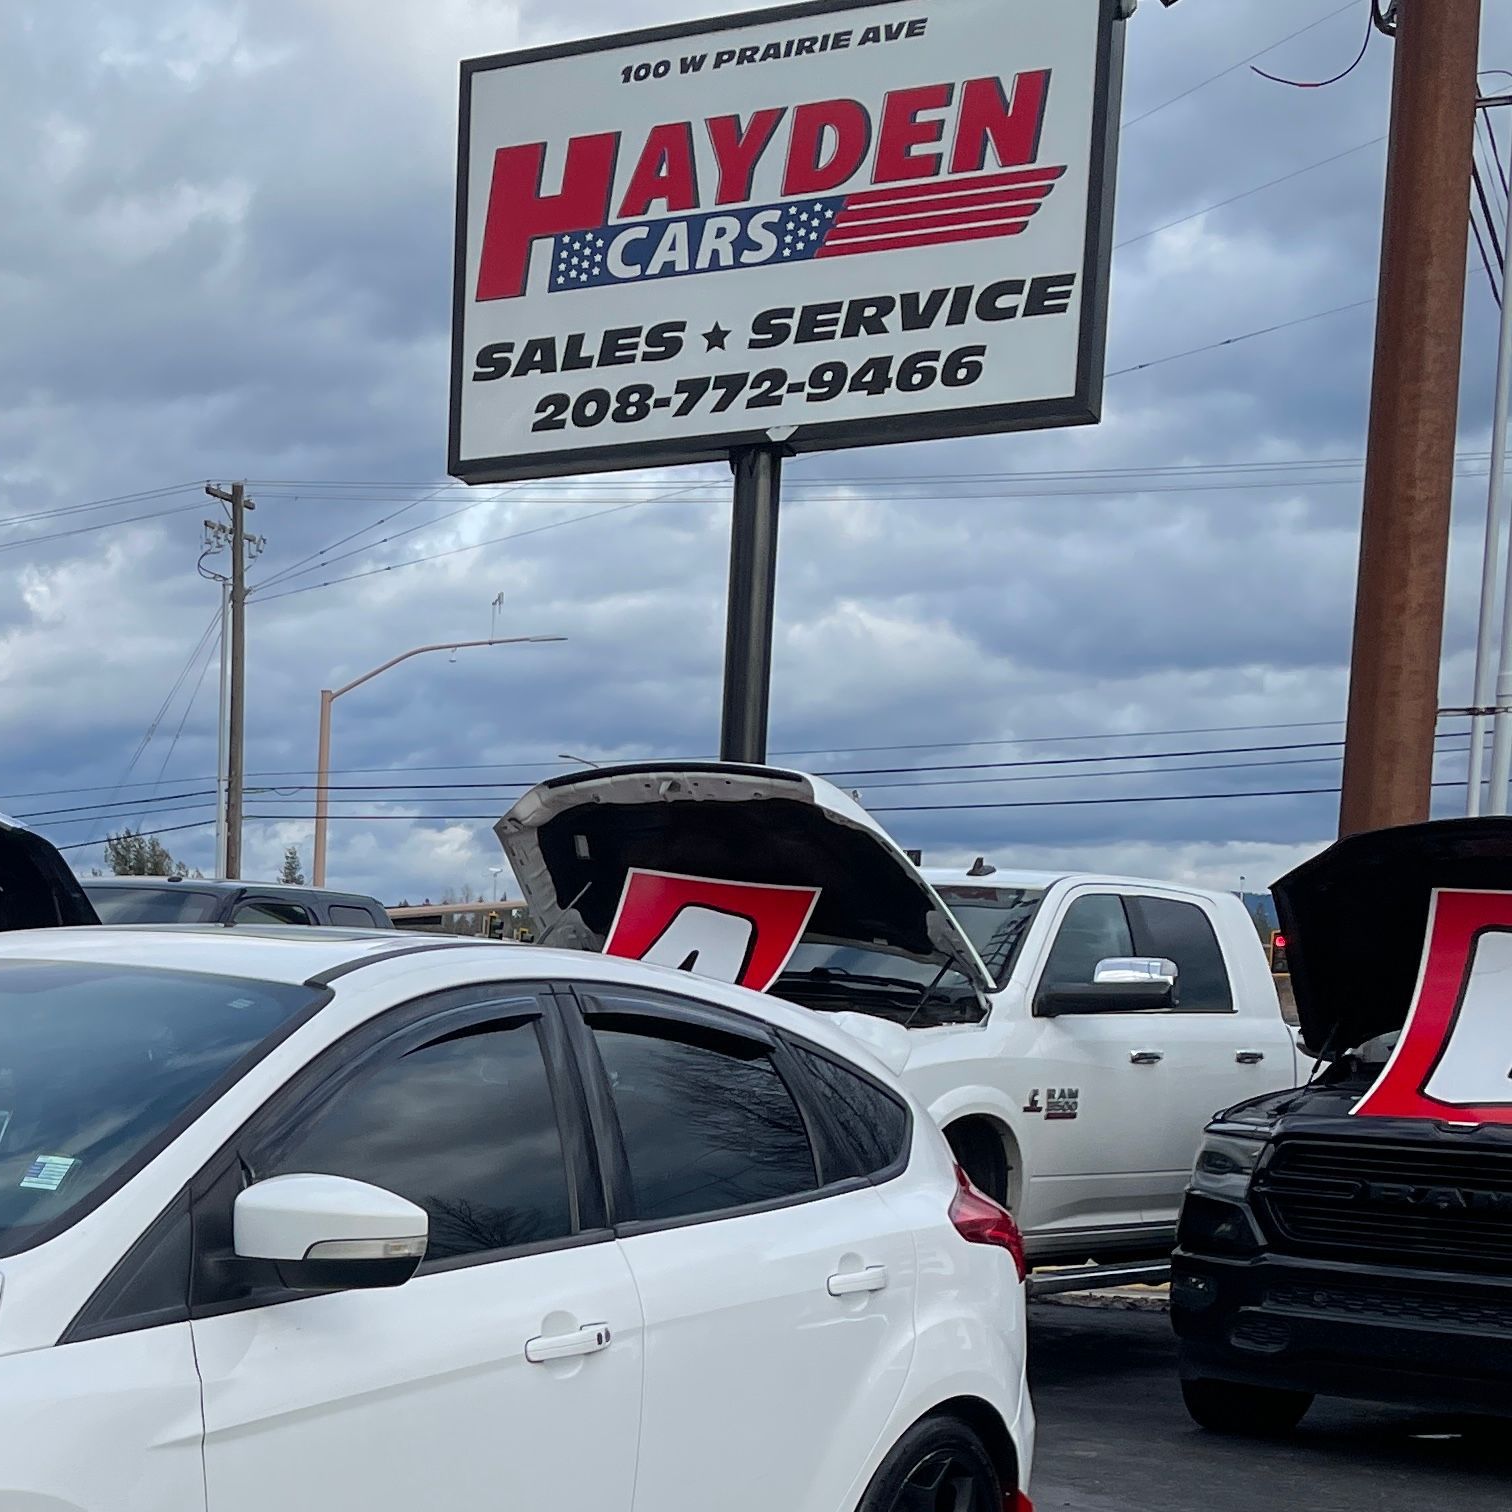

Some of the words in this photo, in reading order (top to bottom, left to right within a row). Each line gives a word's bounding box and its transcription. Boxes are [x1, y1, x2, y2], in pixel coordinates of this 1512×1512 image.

[622, 61, 671, 84] 100
[679, 55, 708, 75] W
[713, 30, 853, 70] PRAIRIE
[859, 18, 929, 46] AVE
[475, 69, 1052, 302] HAYDEN
[606, 208, 782, 280] CARS
[473, 321, 687, 381] SALES
[747, 273, 1078, 349] SERVICE
[531, 345, 987, 432] 208-772-9466
[1047, 1088, 1079, 1099] RAM
